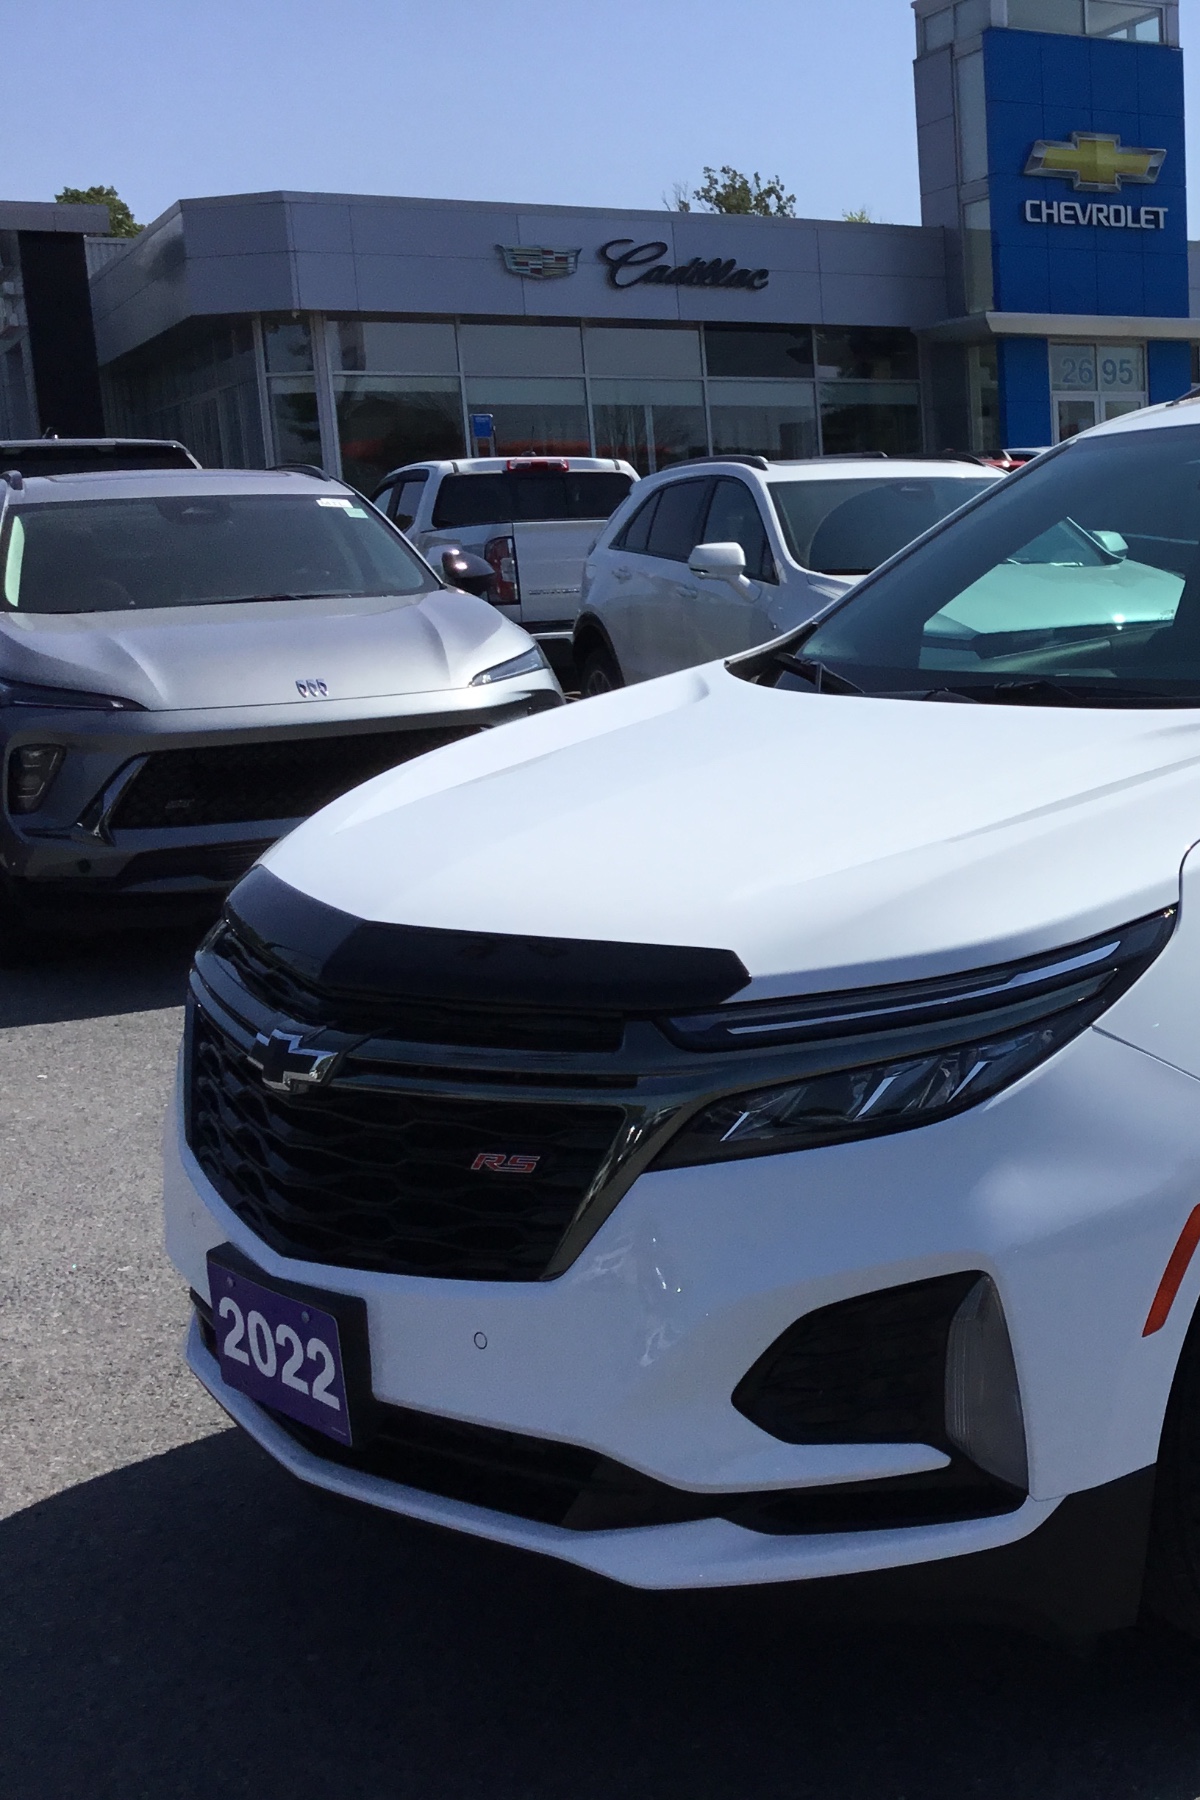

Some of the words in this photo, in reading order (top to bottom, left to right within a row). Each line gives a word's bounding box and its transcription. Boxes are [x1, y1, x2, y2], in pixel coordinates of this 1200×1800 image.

[1025, 199, 1169, 229] CHEVROLET
[600, 238, 769, 290] Cadillac
[470, 1153, 541, 1173] RS
[218, 1296, 341, 1411] 2022
